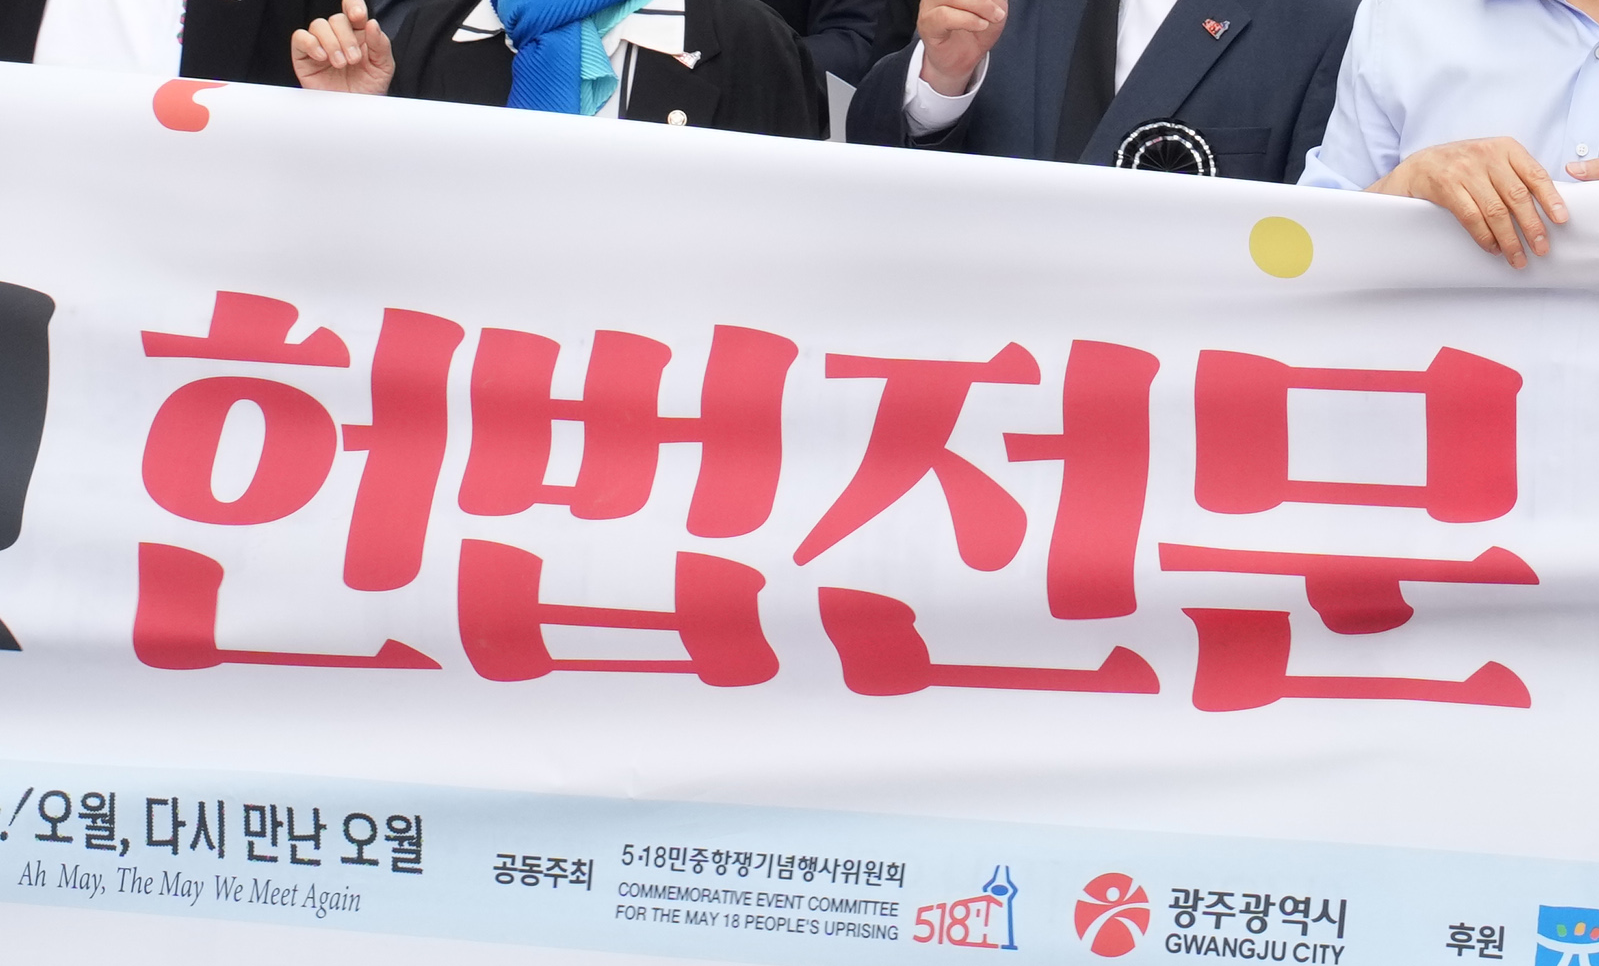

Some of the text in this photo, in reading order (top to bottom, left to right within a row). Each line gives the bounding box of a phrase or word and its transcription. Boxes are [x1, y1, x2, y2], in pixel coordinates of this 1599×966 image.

[132, 290, 1542, 713] 헌법전문
[145, 795, 226, 860] 다시
[242, 801, 328, 867] 만난
[340, 811, 425, 875] 오월
[17, 859, 362, 919] Ah May, The May We Meet Again
[492, 851, 595, 891] 공동주최
[617, 881, 900, 918] COMMEMORATIVE EVENT COMMITTEE
[1167, 886, 1348, 941] 광주광역시
[615, 904, 900, 941] FOR THE MAY 18 PEOPLE'S UPRISING
[1445, 920, 1505, 960] 후원
[1164, 933, 1346, 966] GWANGJU CITY
